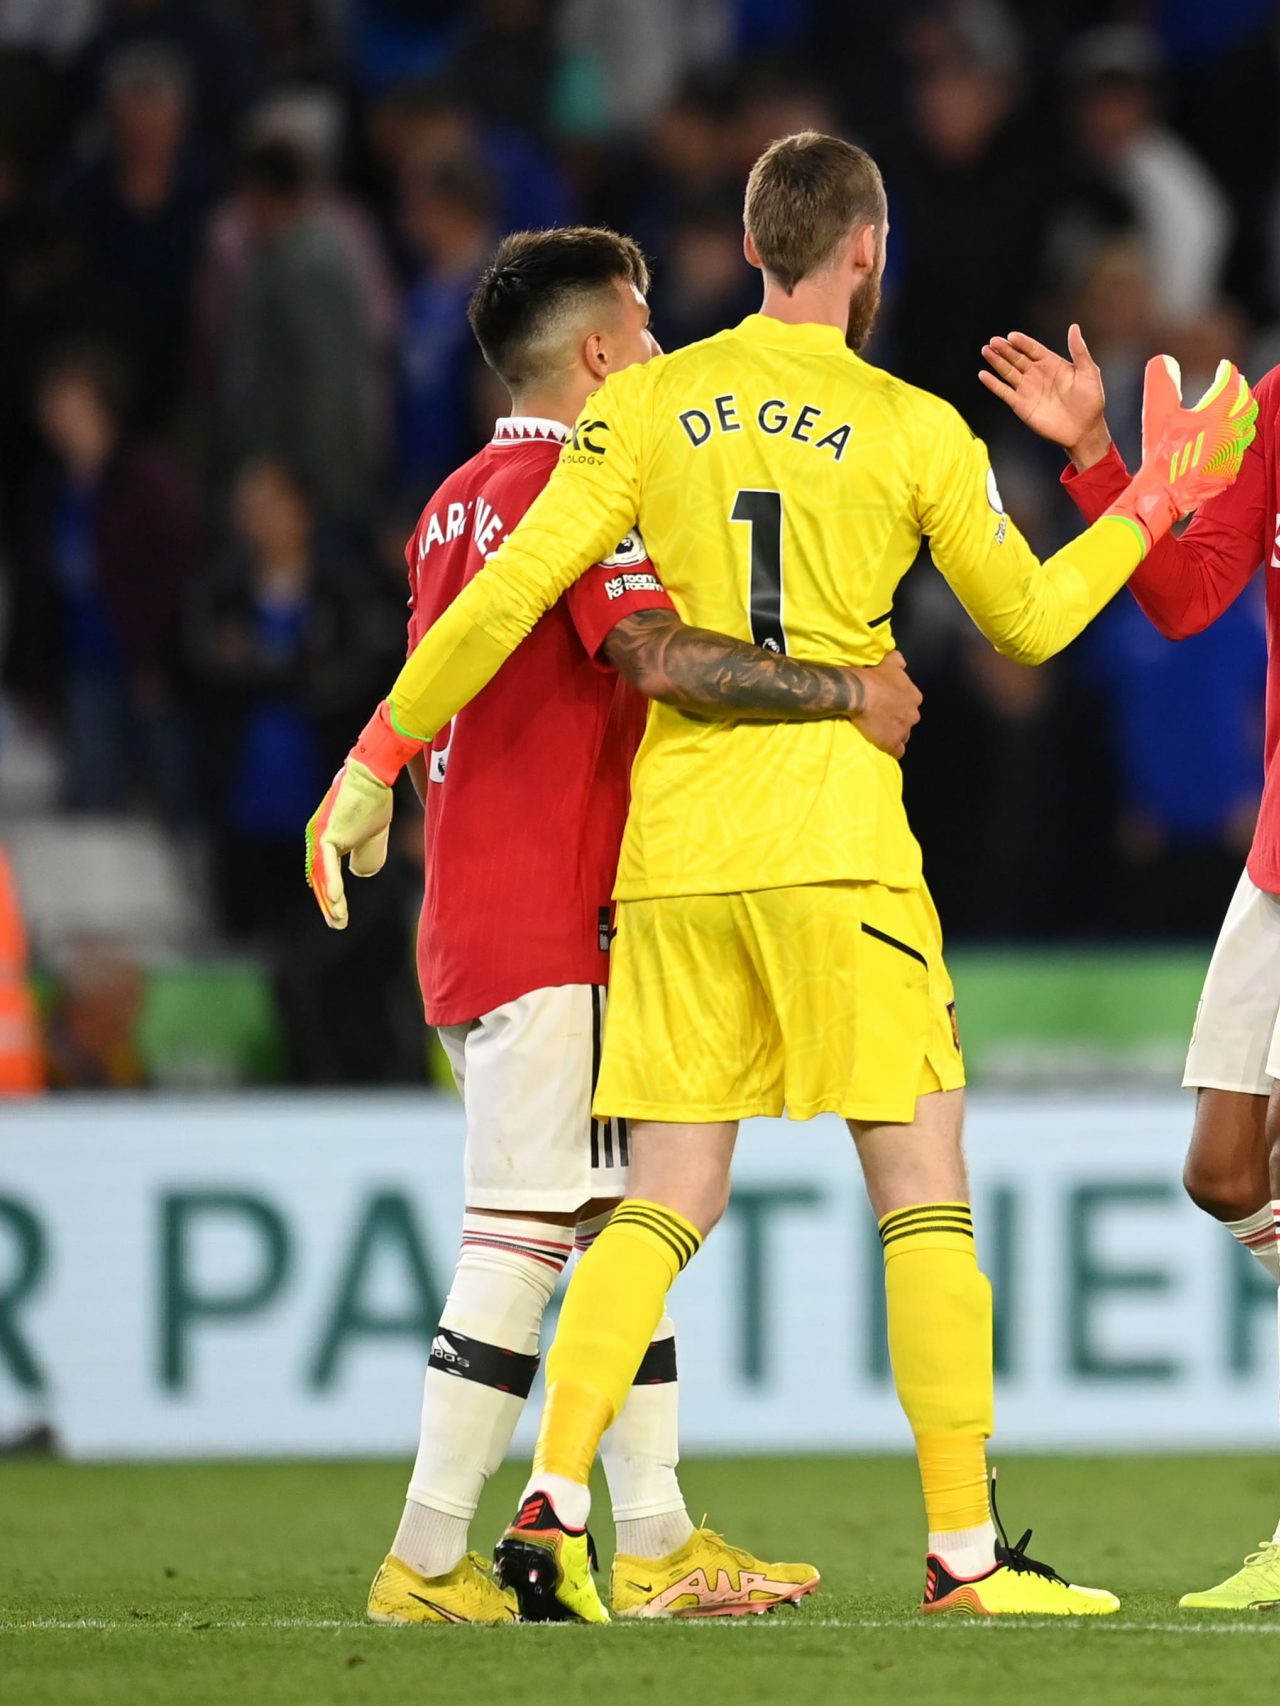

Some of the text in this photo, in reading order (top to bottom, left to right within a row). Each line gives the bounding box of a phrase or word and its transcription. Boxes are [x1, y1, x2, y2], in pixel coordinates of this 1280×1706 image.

[678, 394, 853, 462] DE GEA
[729, 488, 788, 657] 1
